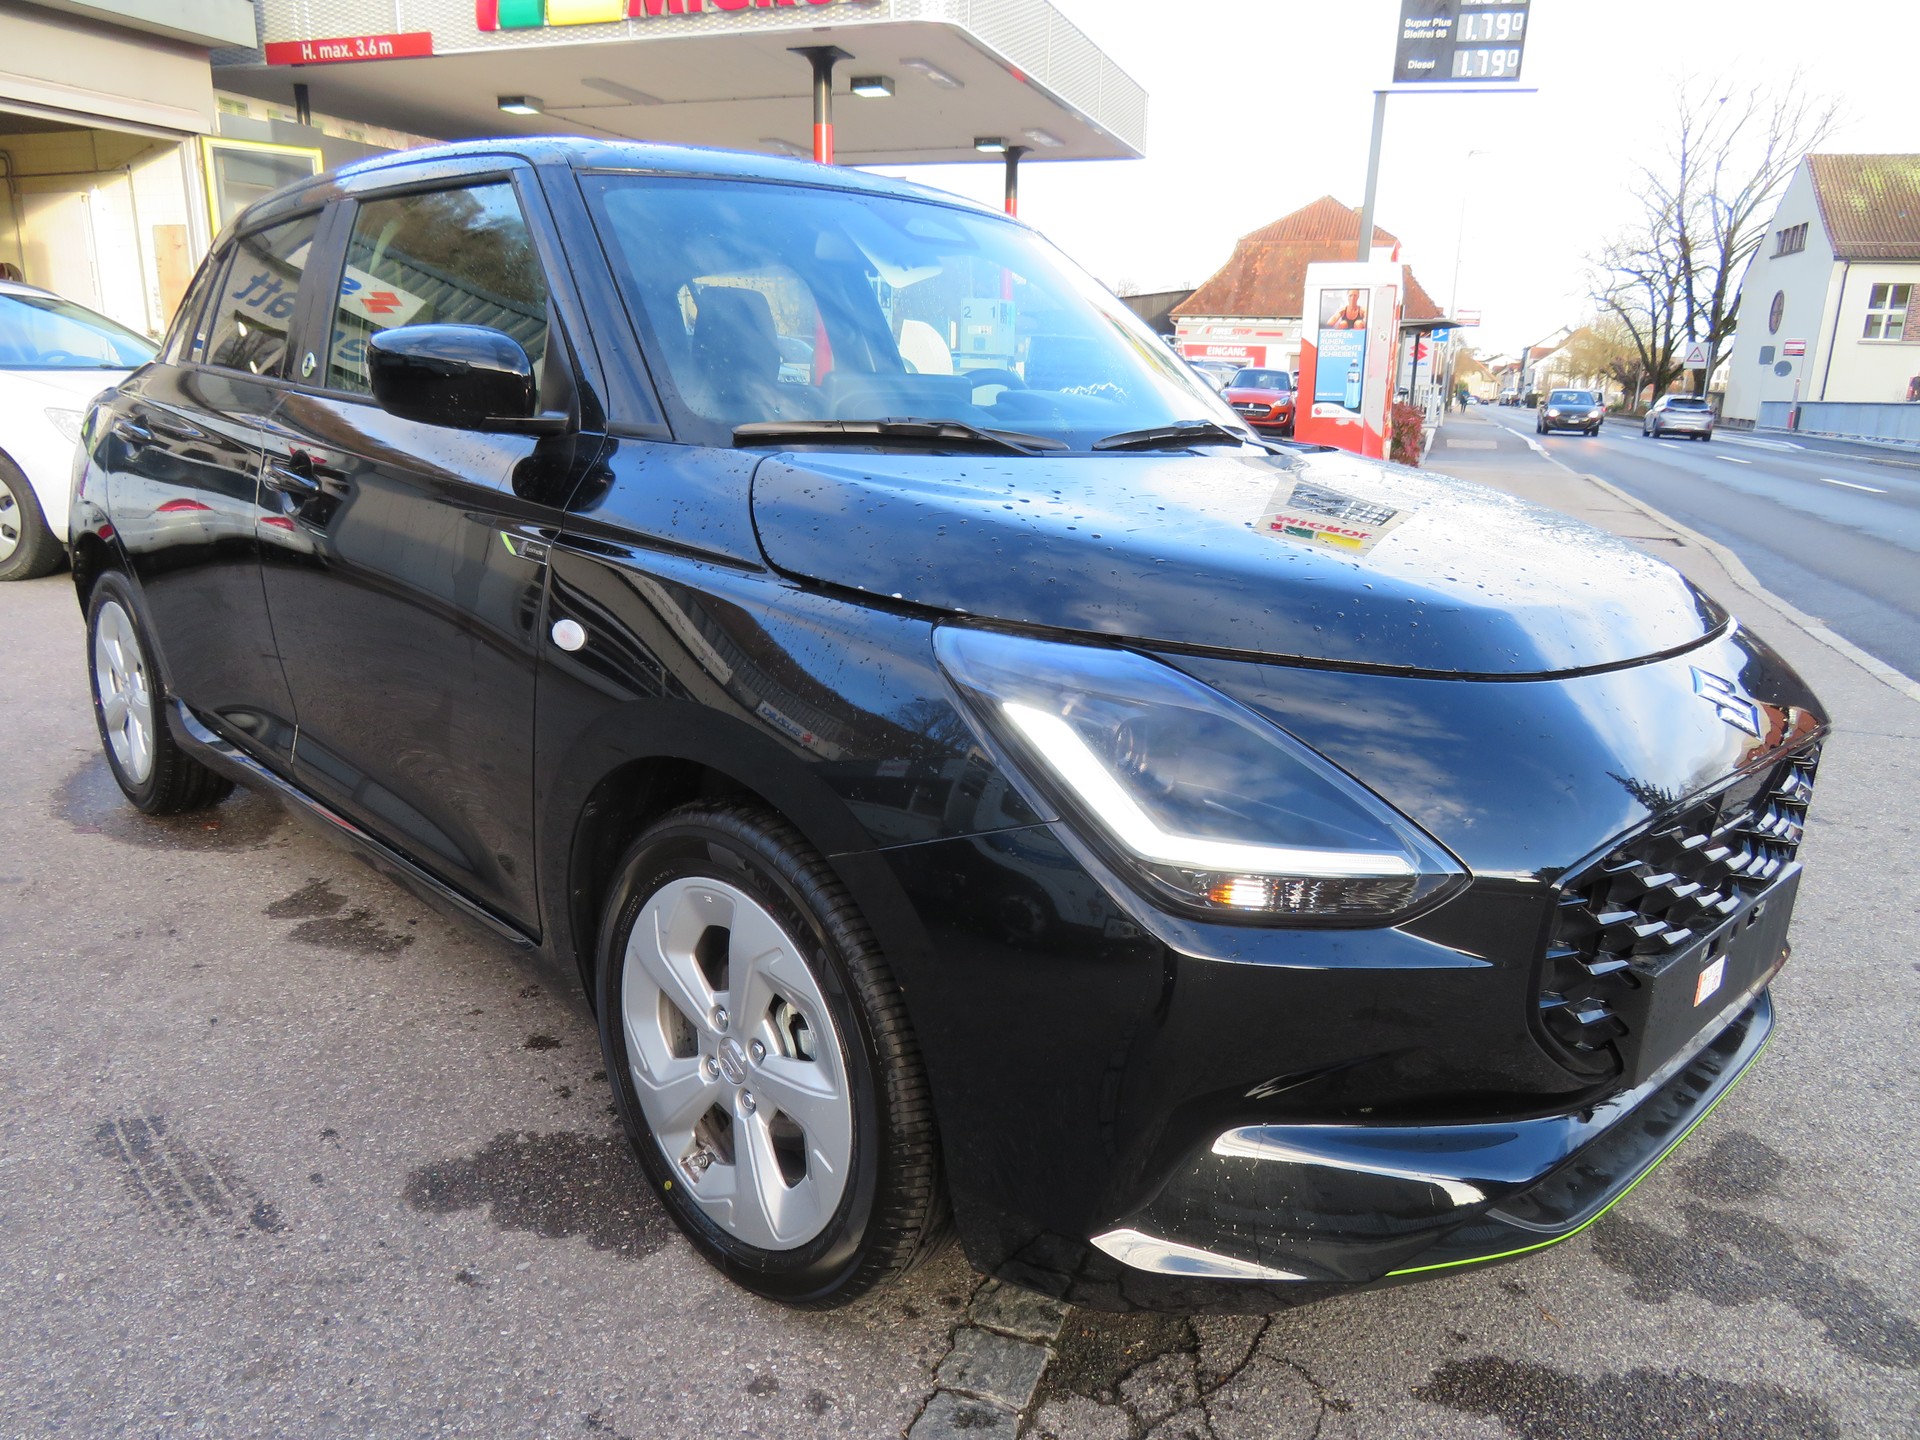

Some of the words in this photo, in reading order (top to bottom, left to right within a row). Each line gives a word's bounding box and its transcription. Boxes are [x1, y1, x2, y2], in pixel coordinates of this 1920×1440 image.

[1405, 18, 1431, 28] Super
[1432, 17, 1452, 27] Plus
[1404, 29, 1434, 39] Bleifrei
[302, 43, 316, 60] H.
[319, 45, 353, 59] max.
[356, 39, 377, 57] 3.6
[379, 41, 393, 55] m
[1408, 60, 1435, 69] Diesel
[963, 305, 972, 319] 2
[1206, 346, 1247, 357] EINGANG
